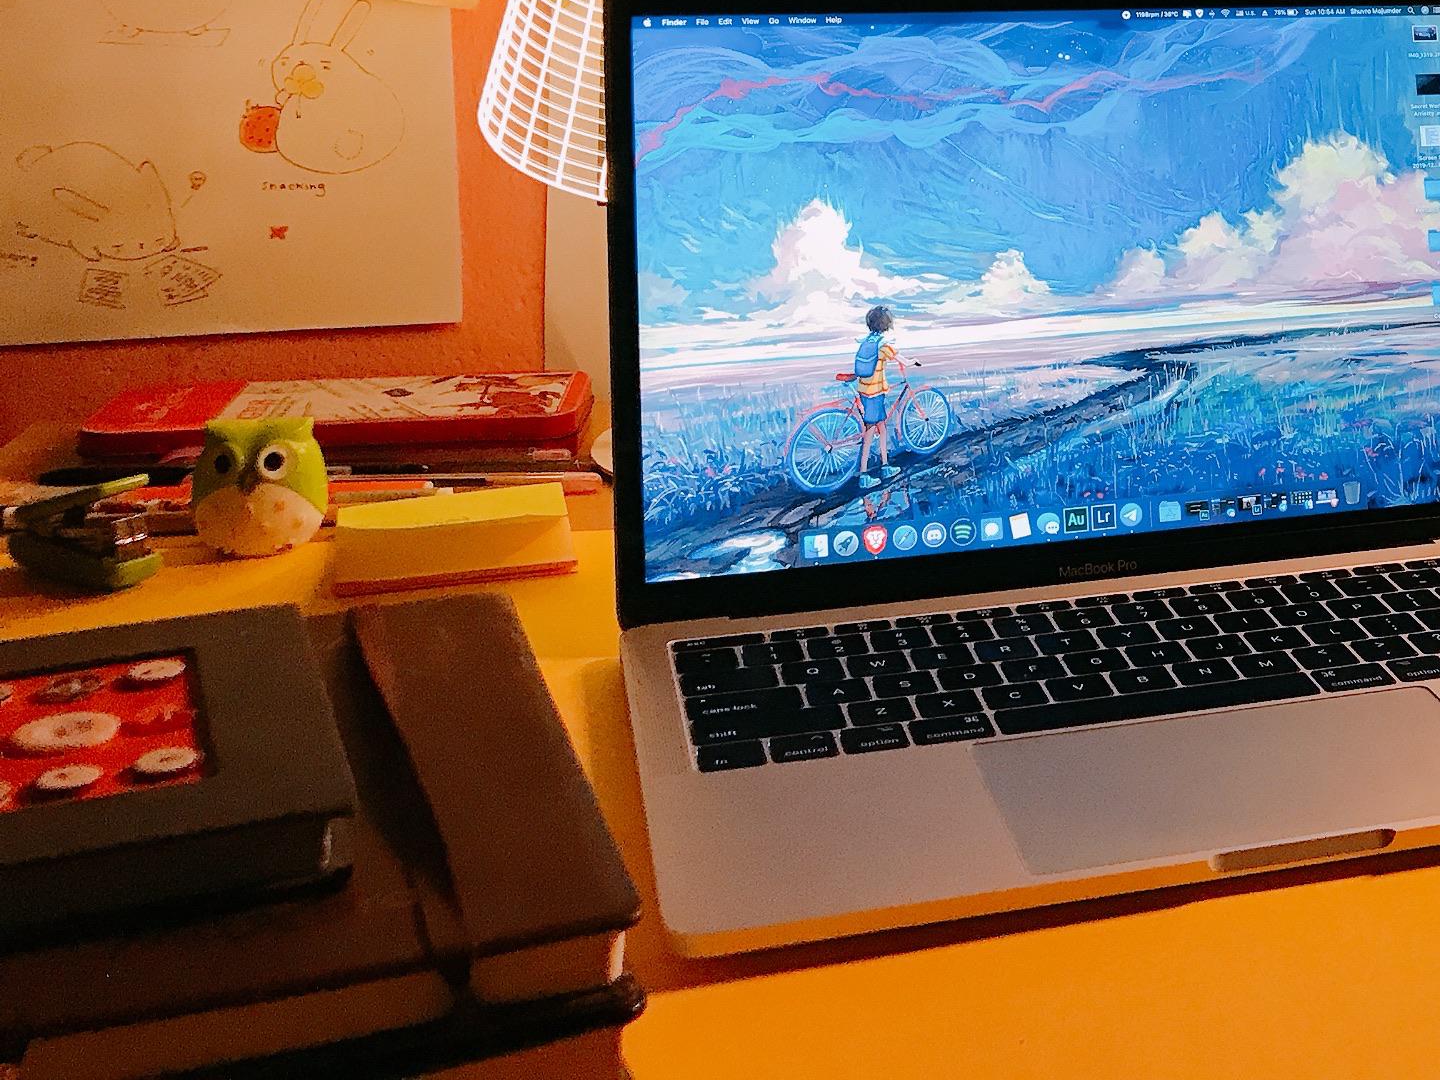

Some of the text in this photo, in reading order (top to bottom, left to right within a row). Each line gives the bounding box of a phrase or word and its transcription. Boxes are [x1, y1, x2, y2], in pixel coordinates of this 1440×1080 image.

[1304, 8, 1317, 17] Sun
[1335, 8, 1346, 16] AM
[661, 15, 843, 26] Finder File Edit View Go Window Help
[1068, 509, 1085, 526] Au
[1096, 507, 1111, 524] Lr
[1058, 558, 1138, 578] MacBook Pro
[696, 683, 716, 691] tab
[702, 703, 758, 715] caps lock
[784, 668, 1440, 757] control option command command option
[708, 729, 737, 738] shift
